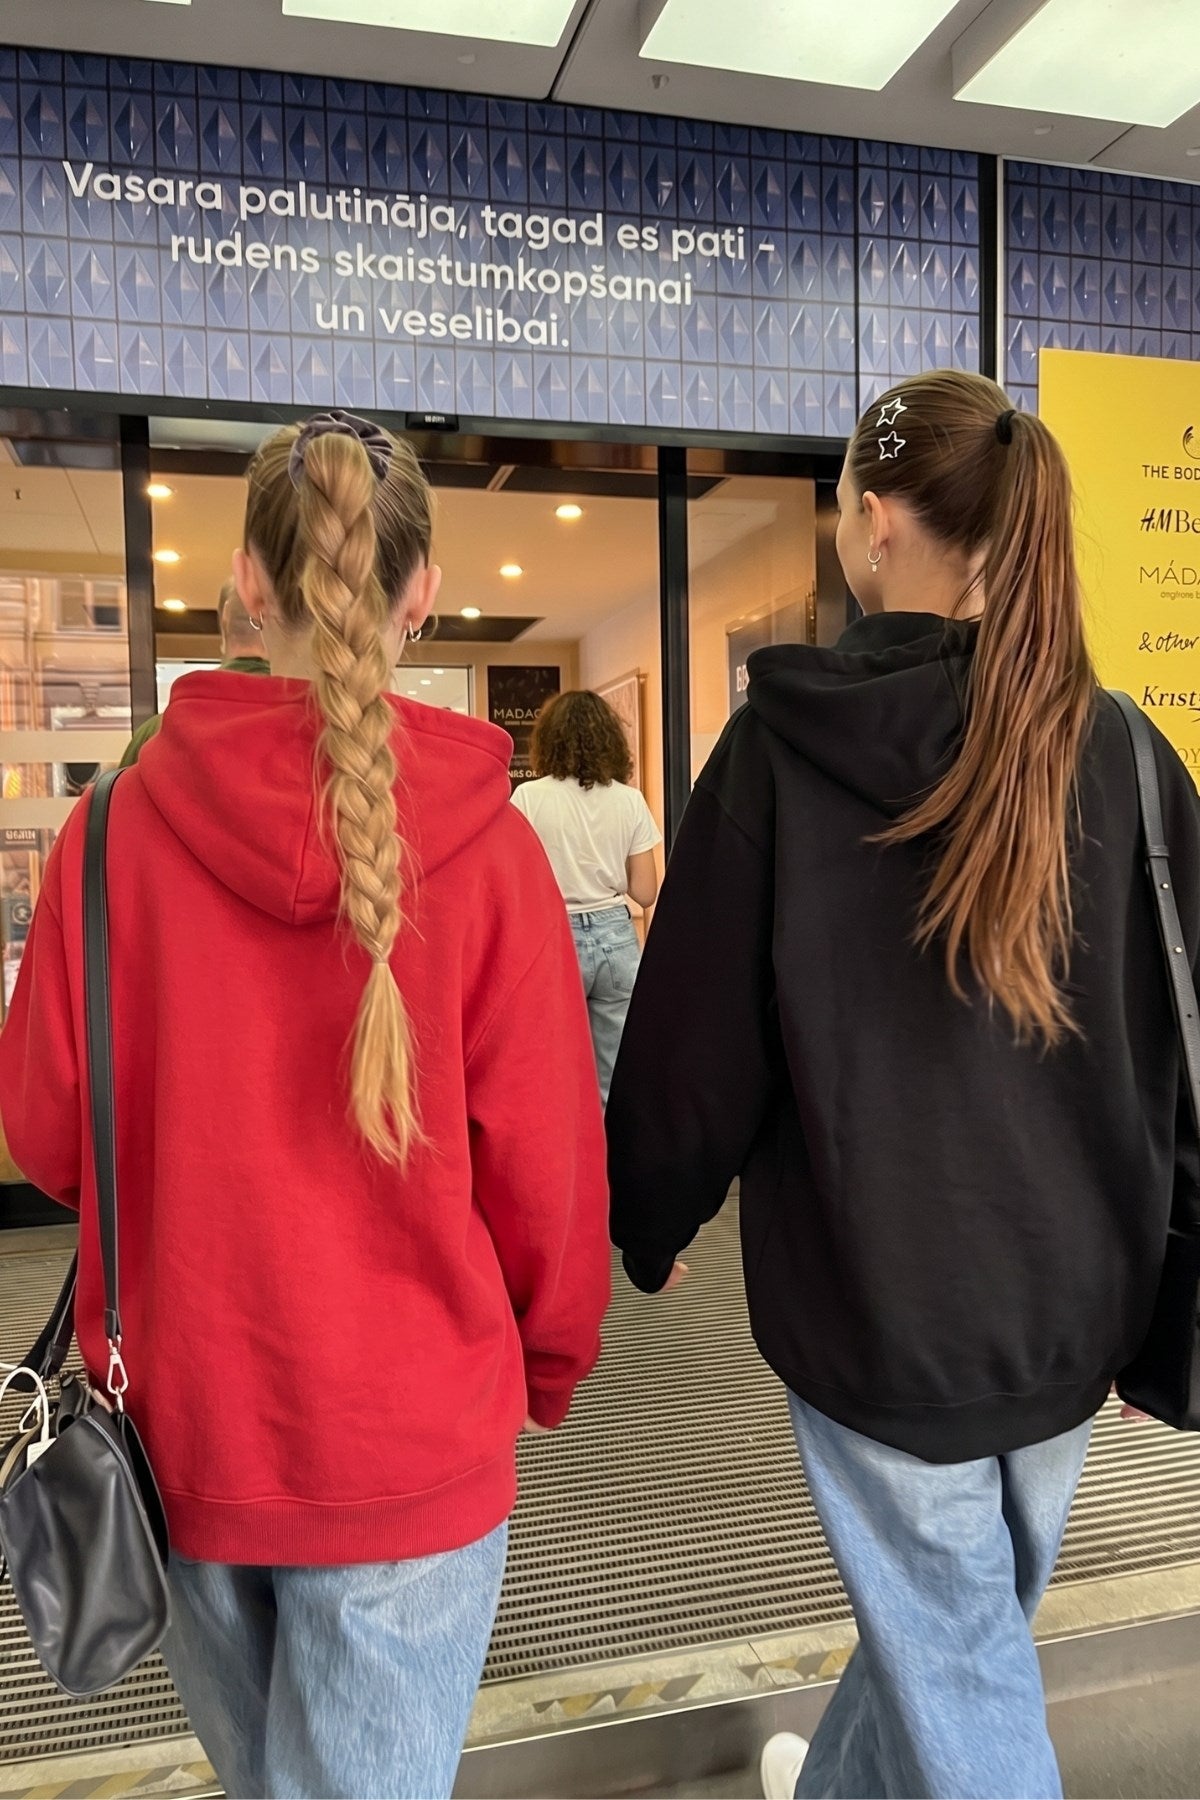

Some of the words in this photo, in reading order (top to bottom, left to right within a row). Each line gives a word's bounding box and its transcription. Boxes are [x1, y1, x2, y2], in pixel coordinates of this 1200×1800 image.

[62, 161, 222, 210] Vasara
[240, 182, 467, 239] palutināja,
[481, 205, 603, 249] tagad
[616, 224, 660, 251] es
[672, 227, 745, 261] pati
[170, 233, 320, 274] rudens
[334, 242, 693, 306] skaistumkopšanai
[315, 302, 365, 332] un
[380, 308, 570, 347] veselibai.
[1142, 465, 1169, 479] THE
[1140, 560, 1200, 585] MÁD
[1139, 632, 1153, 653] &
[1156, 632, 1200, 653] other
[1142, 686, 1200, 707] Krist
